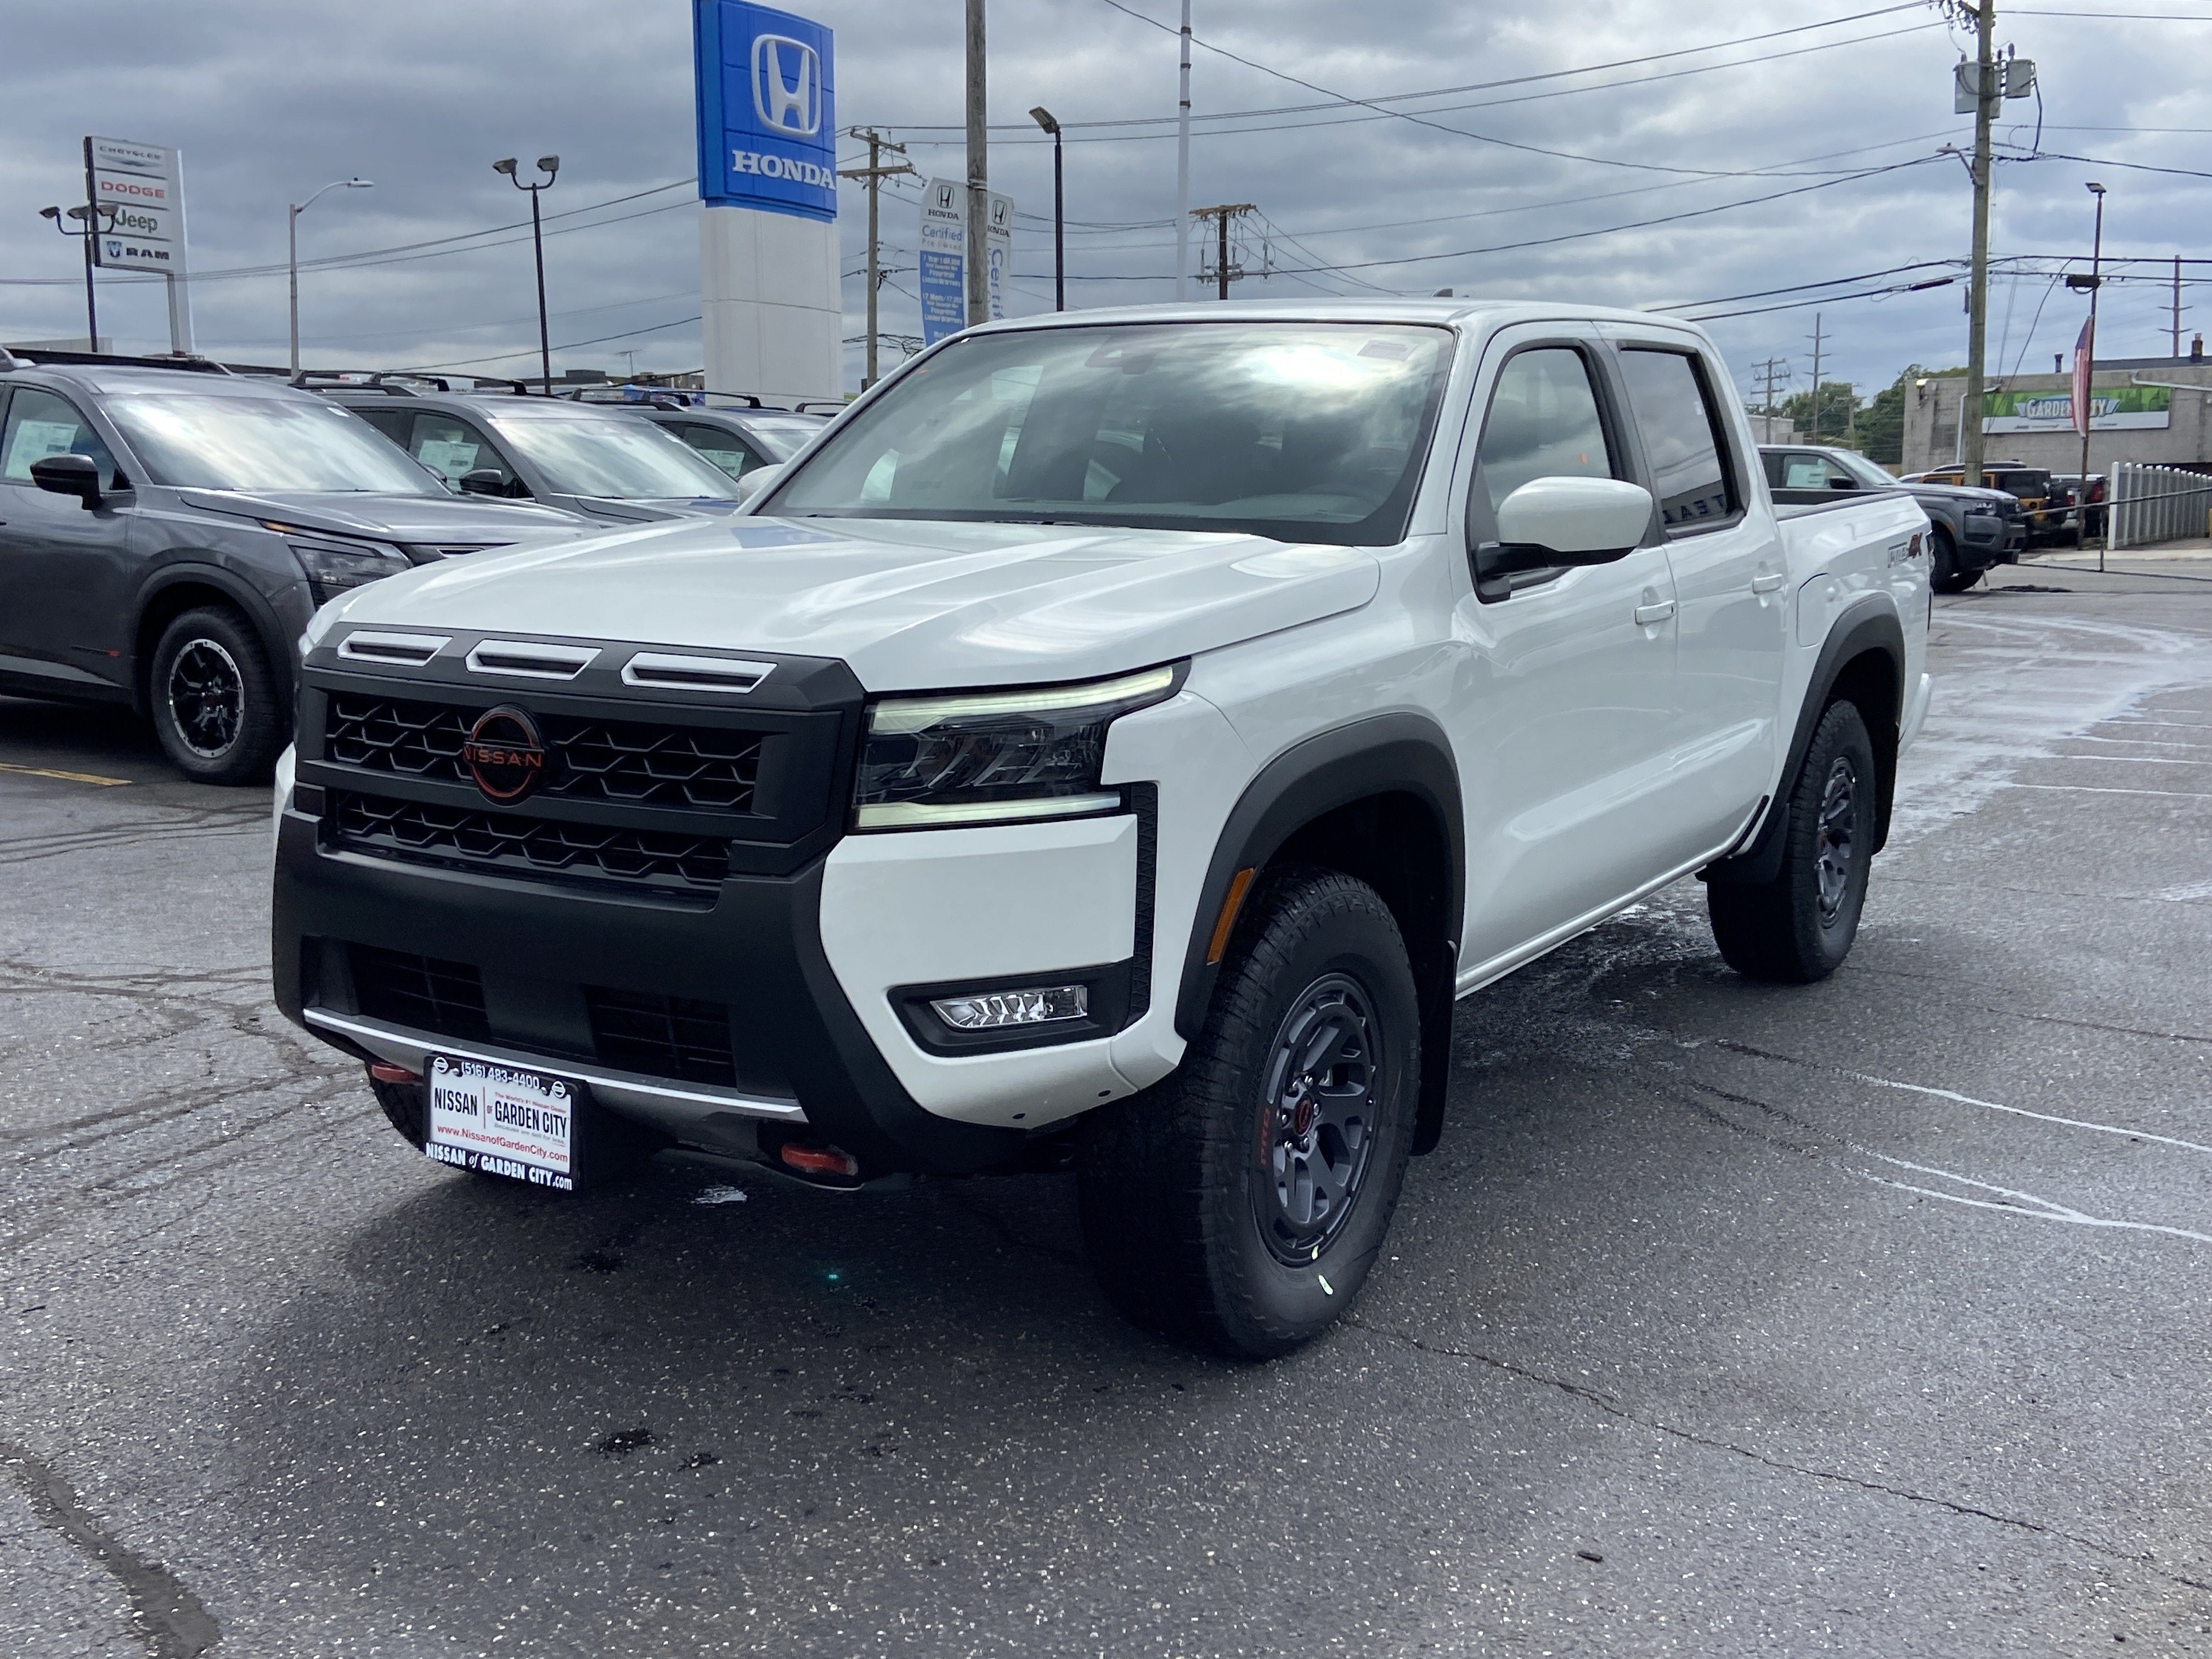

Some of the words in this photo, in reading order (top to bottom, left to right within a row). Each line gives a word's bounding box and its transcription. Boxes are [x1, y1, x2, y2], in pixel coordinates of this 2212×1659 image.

[732, 150, 836, 190] HONDA
[101, 181, 165, 199] DODGE
[115, 209, 158, 234] Jeep
[928, 208, 960, 220] HONDA
[922, 225, 962, 241] Certified
[126, 247, 170, 260] RAM
[463, 746, 542, 768] NISSAN
[461, 1061, 486, 1079] (516)
[488, 1068, 540, 1090] 483-4400
[435, 1087, 477, 1116] NISSAN
[495, 1100, 539, 1131] GARDEN
[543, 1111, 567, 1138] CITY
[437, 1125, 568, 1163] www.NissanofGardenCity.com
[426, 1142, 466, 1166] NISSAN
[469, 1153, 479, 1169] of
[481, 1155, 526, 1180] GARDEN
[528, 1166, 572, 1191] CITY.com
